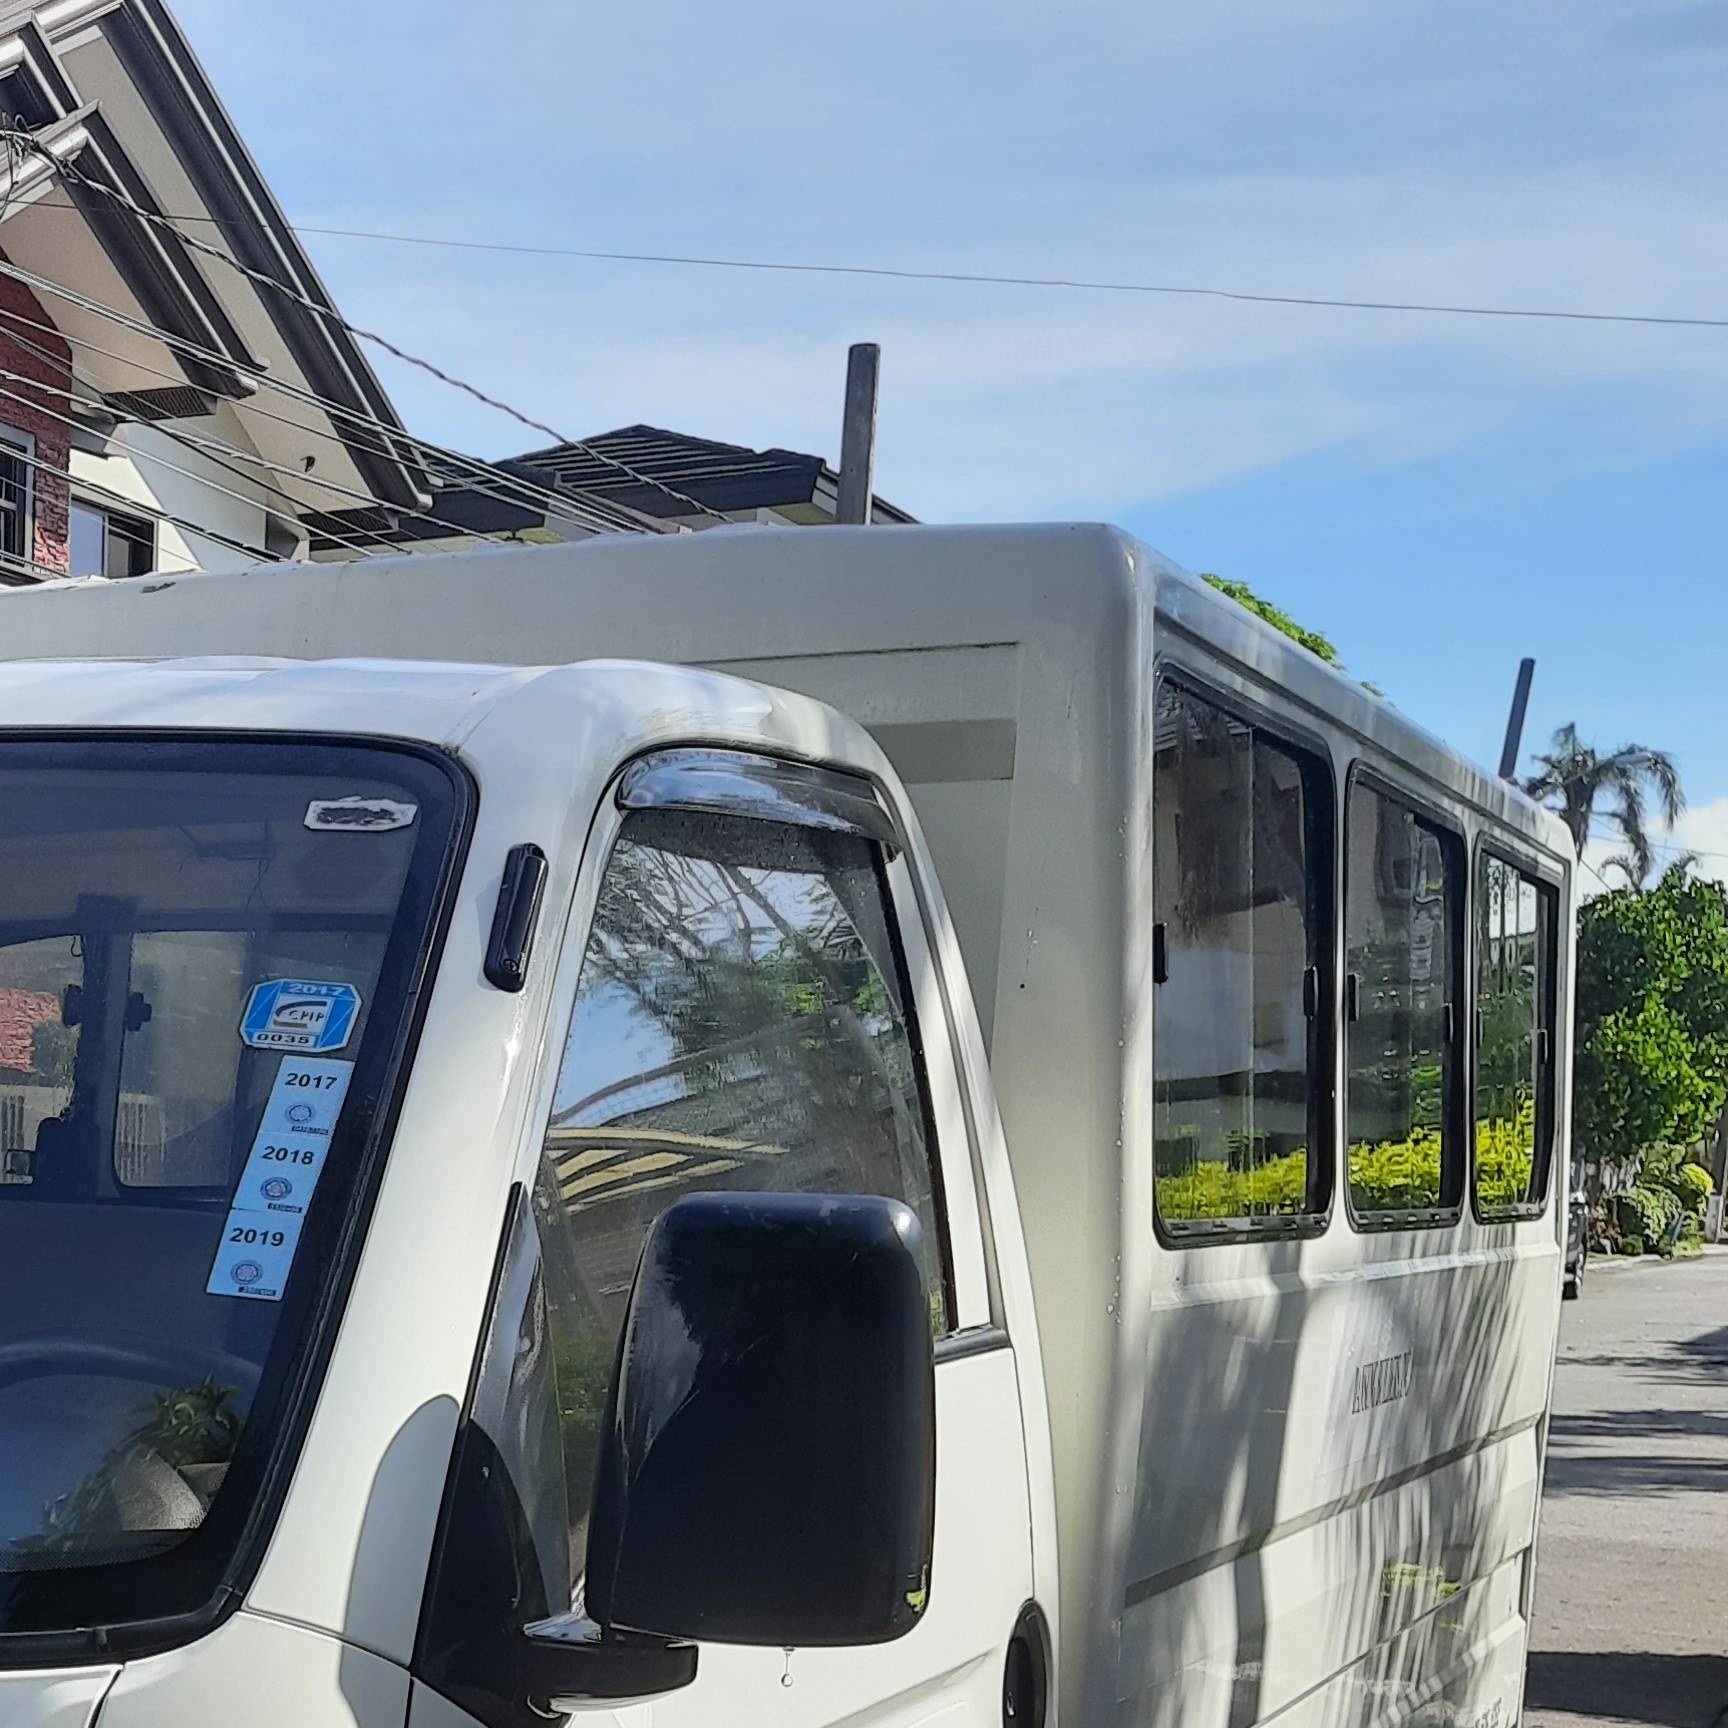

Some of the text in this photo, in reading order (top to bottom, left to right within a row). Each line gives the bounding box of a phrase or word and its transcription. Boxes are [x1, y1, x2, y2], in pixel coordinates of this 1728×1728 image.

[288, 981, 346, 996] 2017
[257, 1033, 310, 1045] 0035
[284, 1072, 338, 1091] 2017
[261, 1145, 315, 1166] 2018
[228, 1227, 285, 1248] 2019
